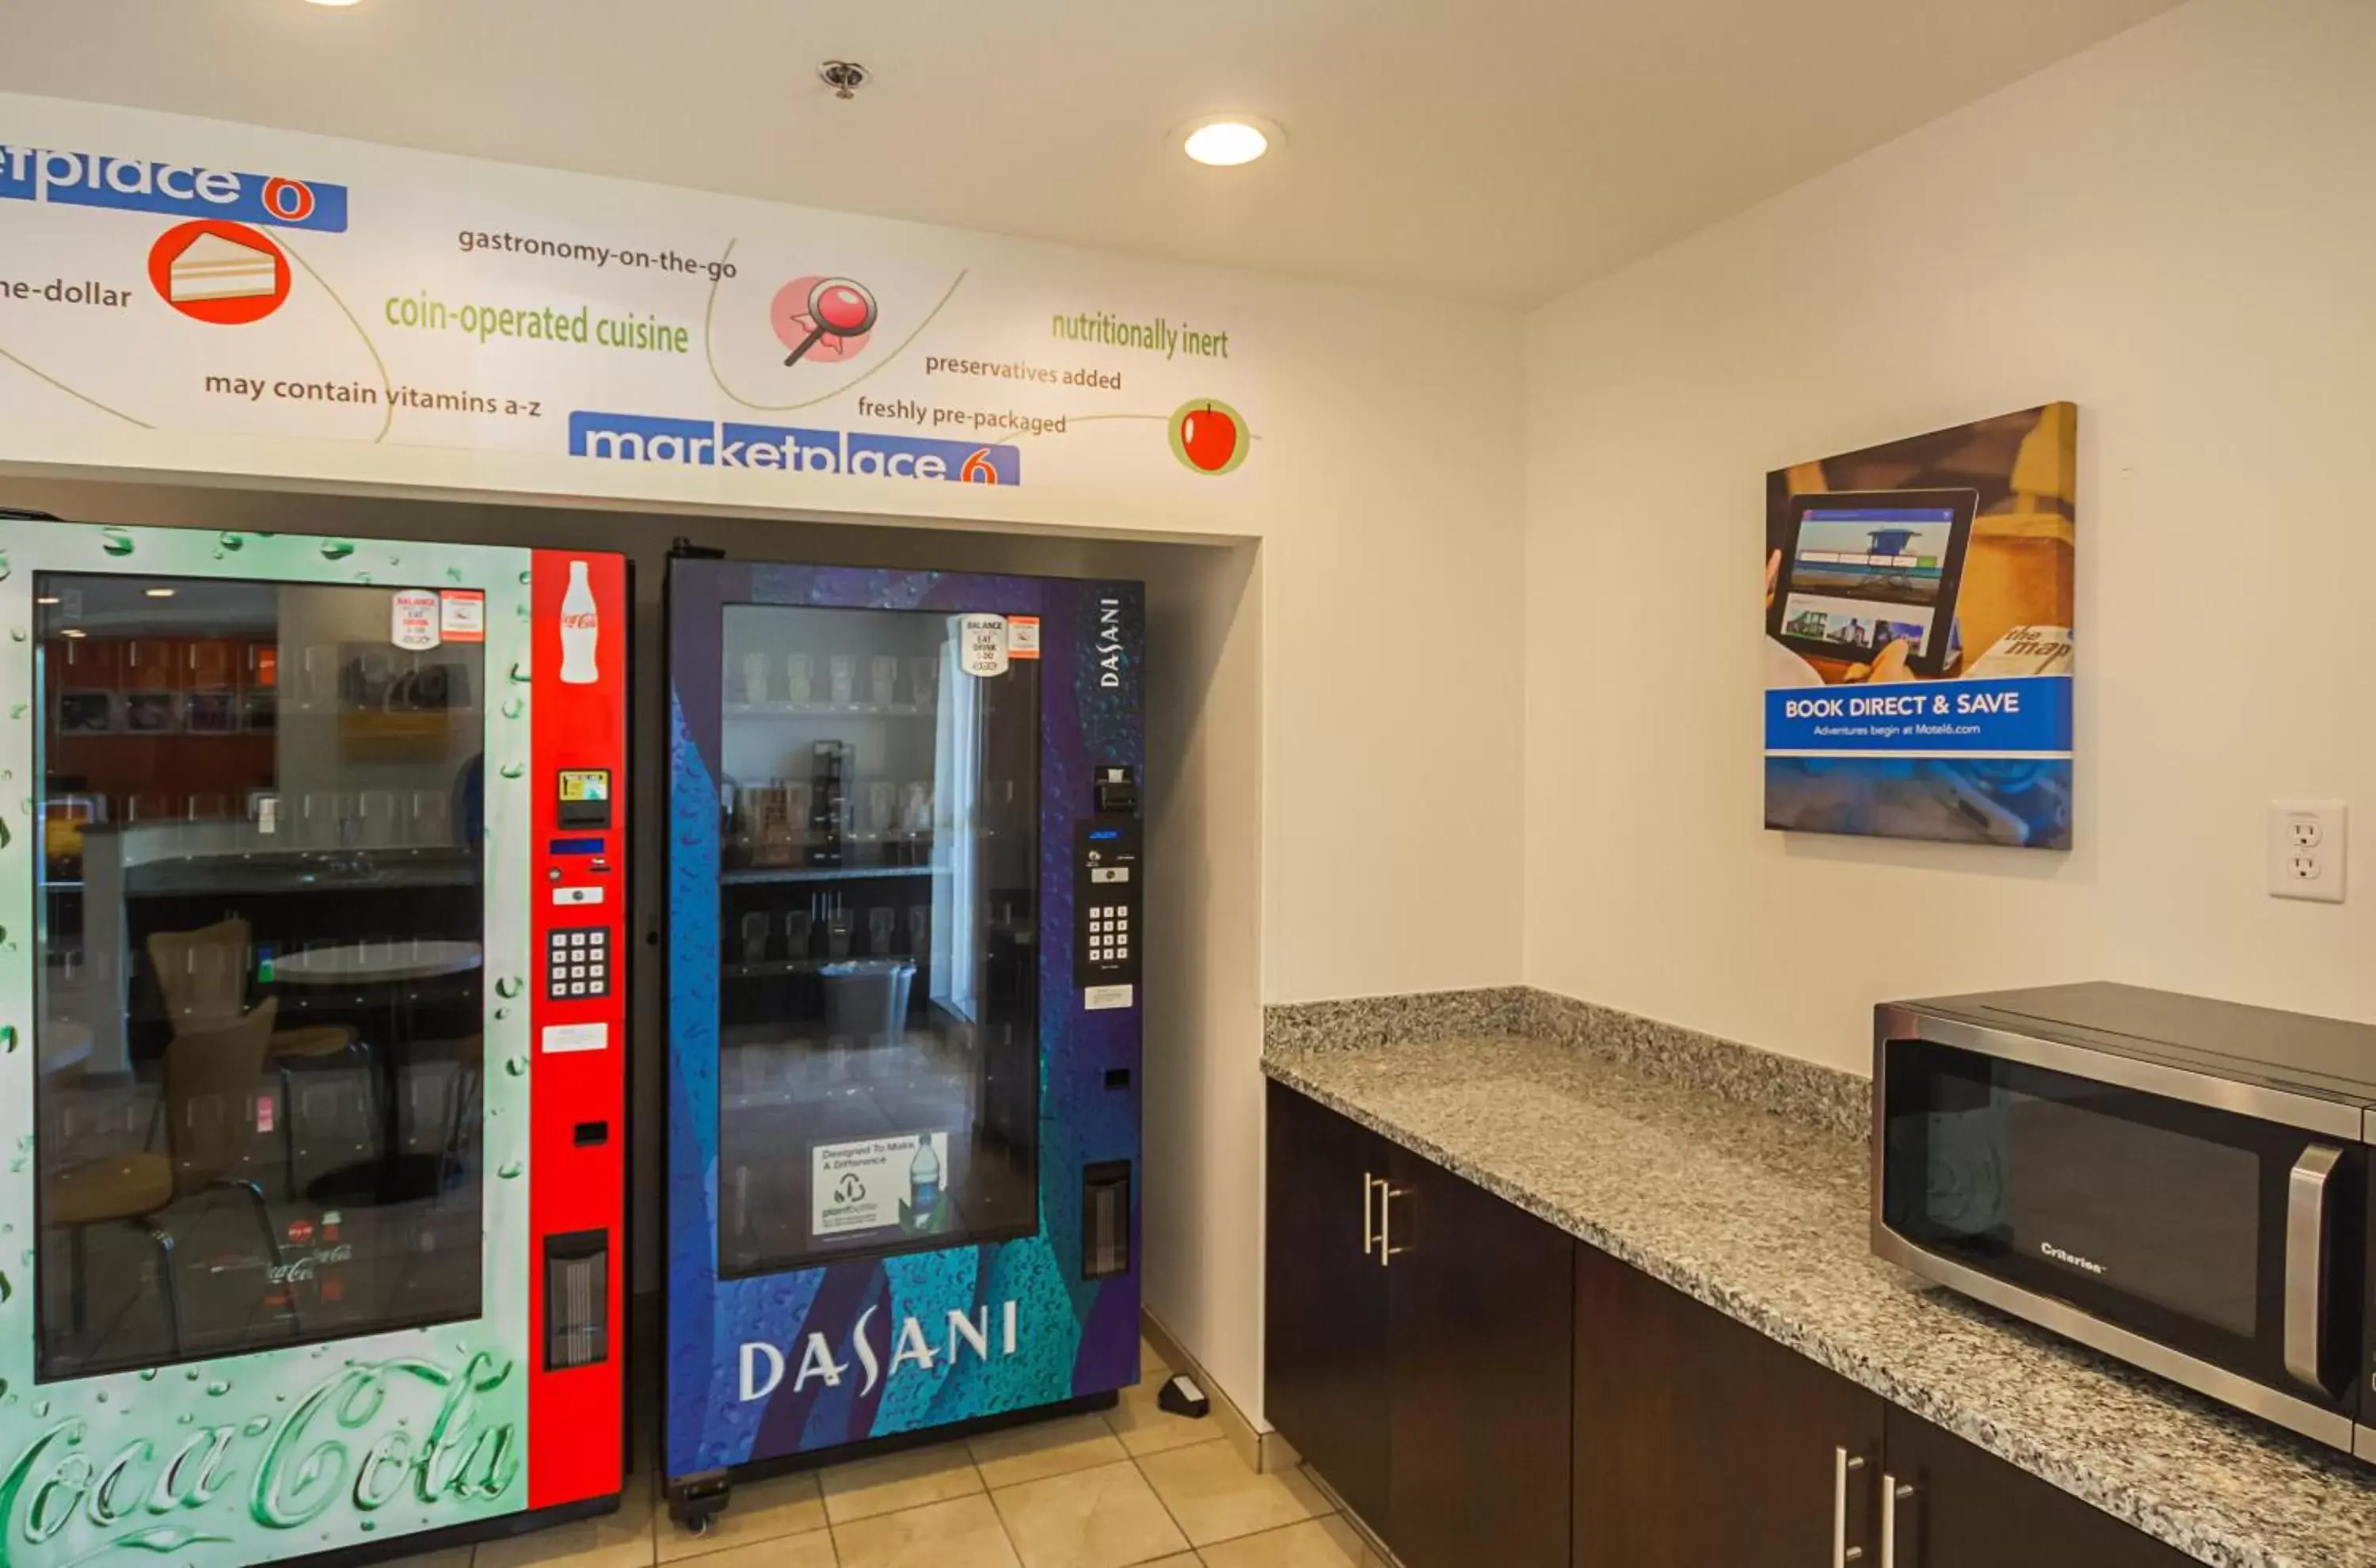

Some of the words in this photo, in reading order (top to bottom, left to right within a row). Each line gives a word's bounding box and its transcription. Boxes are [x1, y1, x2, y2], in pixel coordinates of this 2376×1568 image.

[459, 230, 737, 281] gastronomy-on-the-go
[386, 290, 588, 344] coin-operated
[596, 314, 688, 353] cuisine
[1052, 312, 1177, 360] nutritionally
[1182, 322, 1229, 358] inert
[926, 355, 1058, 385] preservatives
[1062, 370, 1122, 390] added
[204, 375, 265, 402] may
[273, 381, 377, 405] contain
[386, 386, 497, 413] vitamins
[505, 398, 542, 417] a-z
[859, 396, 927, 424] freshly
[933, 406, 1066, 436] pre-packaged
[585, 421, 948, 481] marketplace
[1095, 599, 1125, 687] DASANI
[2005, 624, 2041, 641] the
[2004, 642, 2072, 675] map
[1785, 698, 1843, 718] BOOK
[1849, 695, 1927, 717] DIRECT
[1932, 695, 1950, 715] &
[1956, 692, 2020, 714] SAVE
[1813, 725, 1868, 736] Adventures
[1870, 725, 1899, 737] begin
[1902, 725, 1913, 736] at
[1916, 723, 1981, 735] Motel6.com
[739, 1300, 1017, 1402] DASANI
